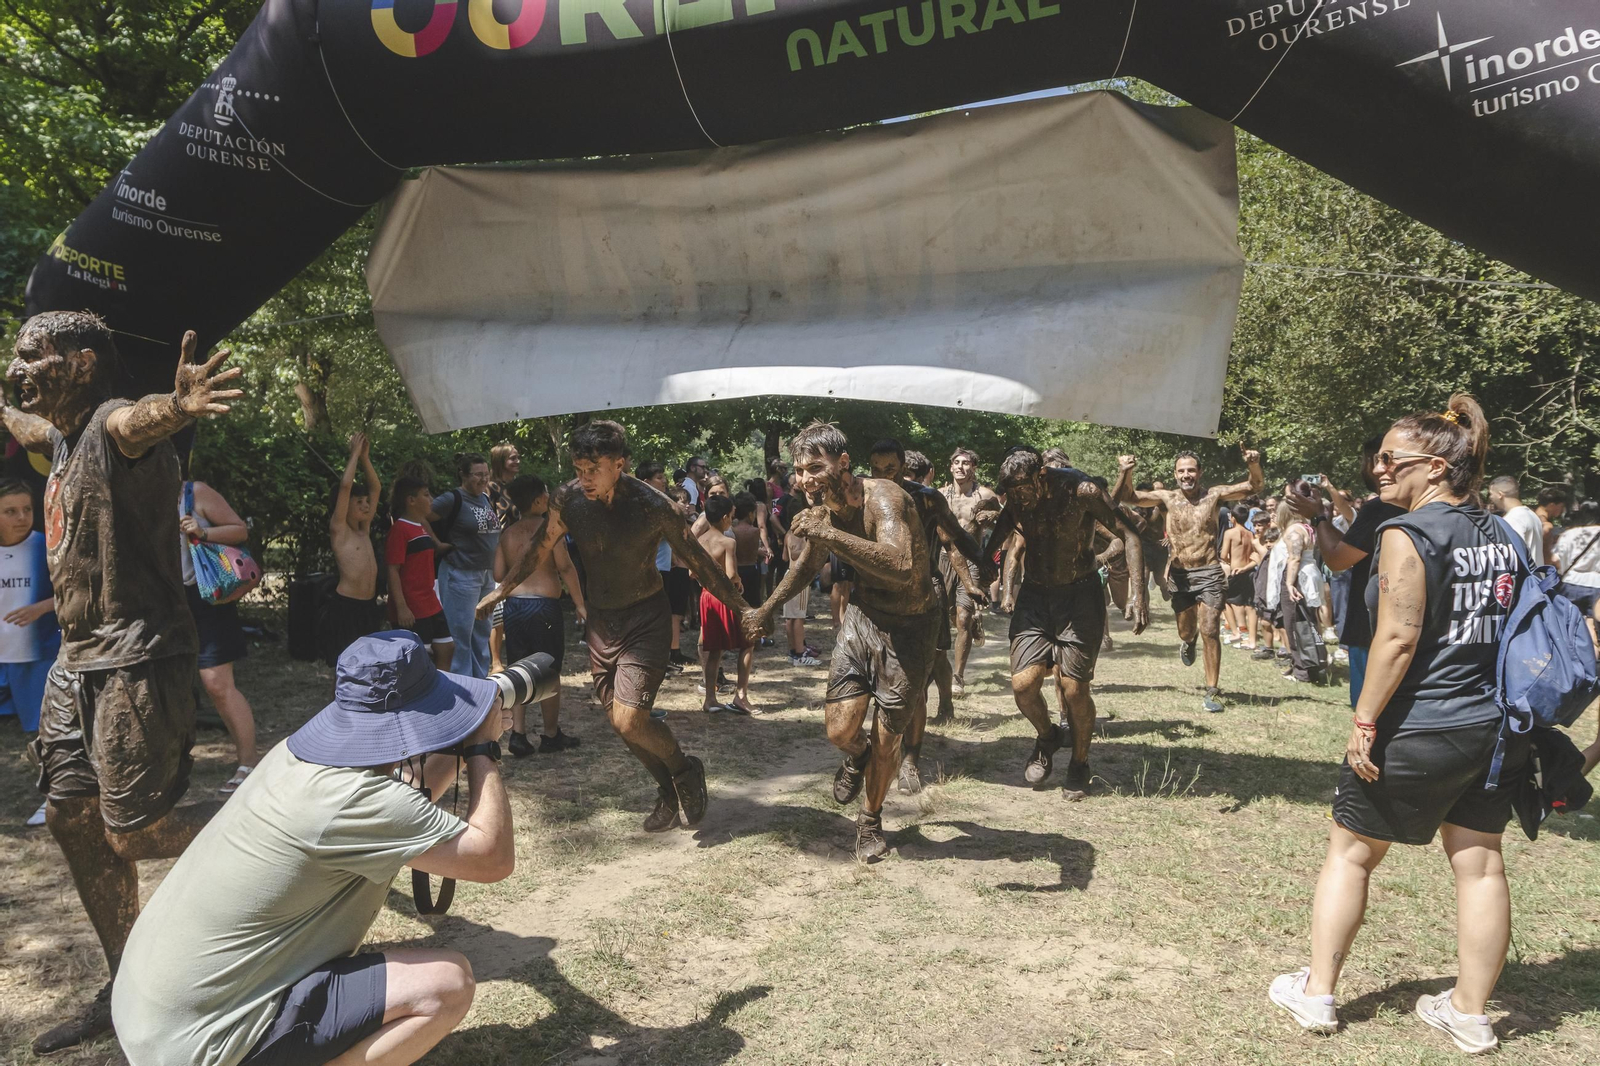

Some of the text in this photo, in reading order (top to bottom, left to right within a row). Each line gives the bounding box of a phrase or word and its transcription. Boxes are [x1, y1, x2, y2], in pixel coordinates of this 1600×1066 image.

[786, 0, 1060, 72] NATURAL
[1464, 26, 1600, 84] inorde
[1472, 75, 1580, 117] turismo
[178, 121, 286, 156] DEPUTACIÓN
[186, 142, 271, 172] OURENSE
[117, 179, 167, 212] inorde
[111, 206, 222, 243] turismo Ourense
[54, 243, 126, 281] DEPORTE
[66, 264, 81, 279] La
[0, 577, 31, 588] MITH
